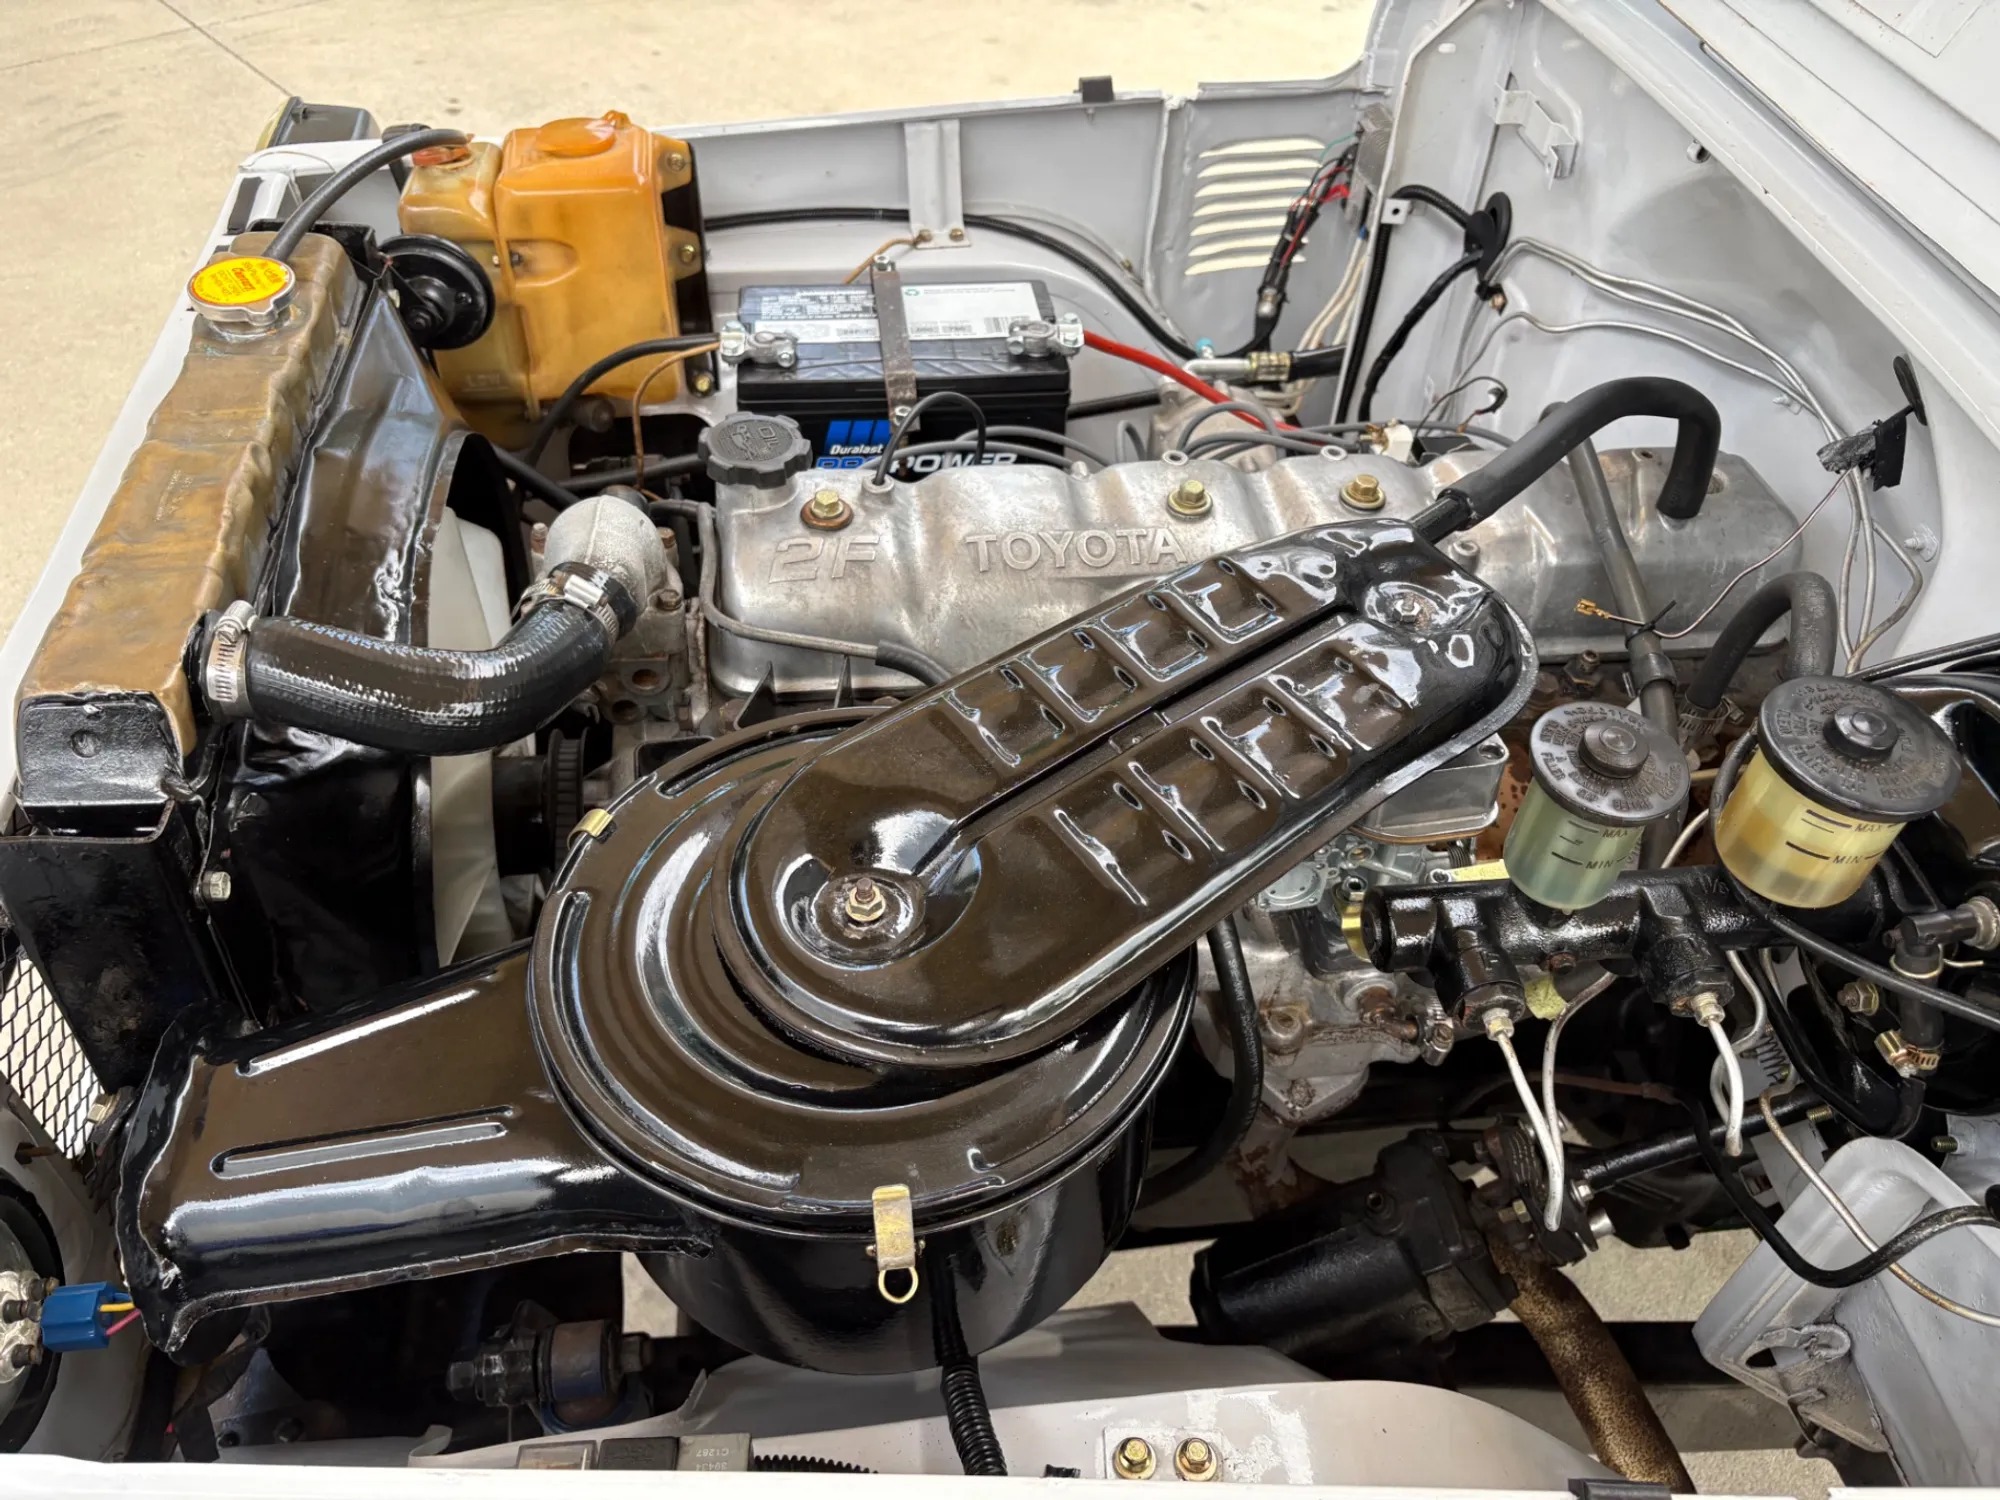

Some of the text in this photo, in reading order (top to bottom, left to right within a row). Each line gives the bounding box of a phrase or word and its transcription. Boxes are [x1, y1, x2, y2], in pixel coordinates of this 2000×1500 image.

[759, 426, 781, 450] OIL
[830, 444, 884, 456] Duralast
[768, 526, 1189, 584] 2F TOYOTA
[1601, 828, 1631, 839] MAX
[1853, 821, 1884, 834] MAX
[1584, 859, 1615, 871] MIN
[1831, 853, 1864, 866] MIN
